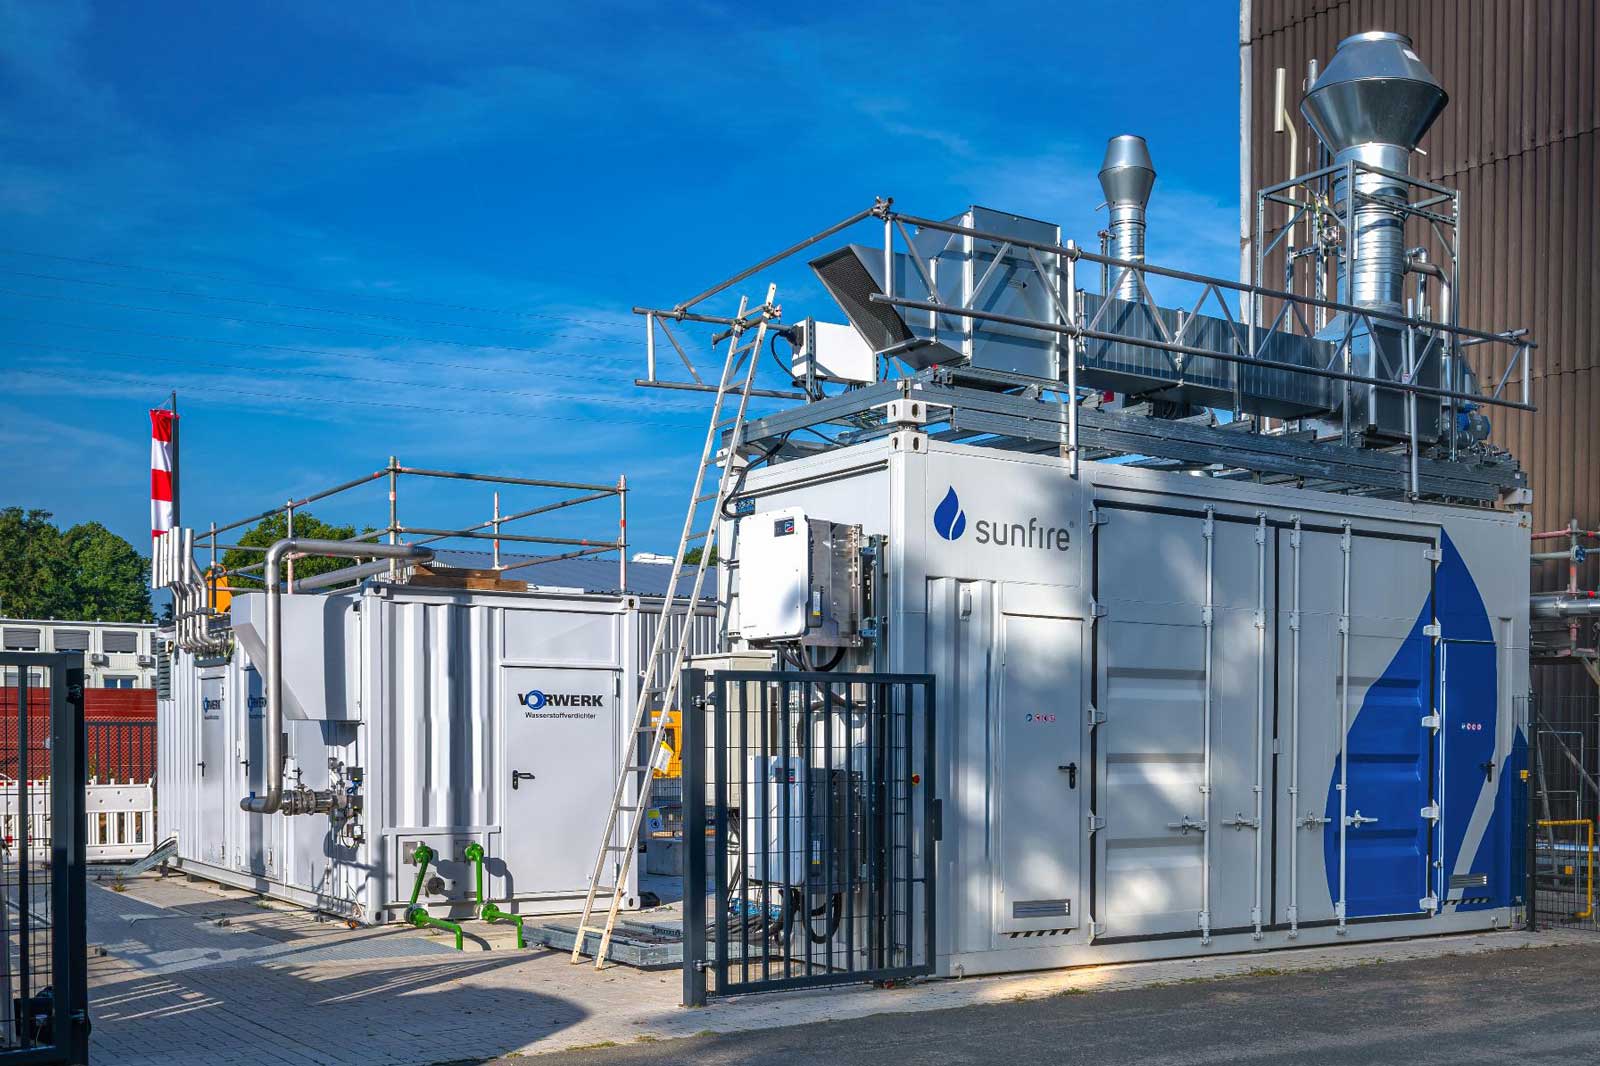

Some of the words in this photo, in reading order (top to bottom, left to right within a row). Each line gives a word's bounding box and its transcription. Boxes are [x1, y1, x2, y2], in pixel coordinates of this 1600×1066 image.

[975, 517, 1070, 551] sunfire
[518, 690, 603, 710] VORWERK
[525, 711, 596, 719] Wasserstoffverdichter
